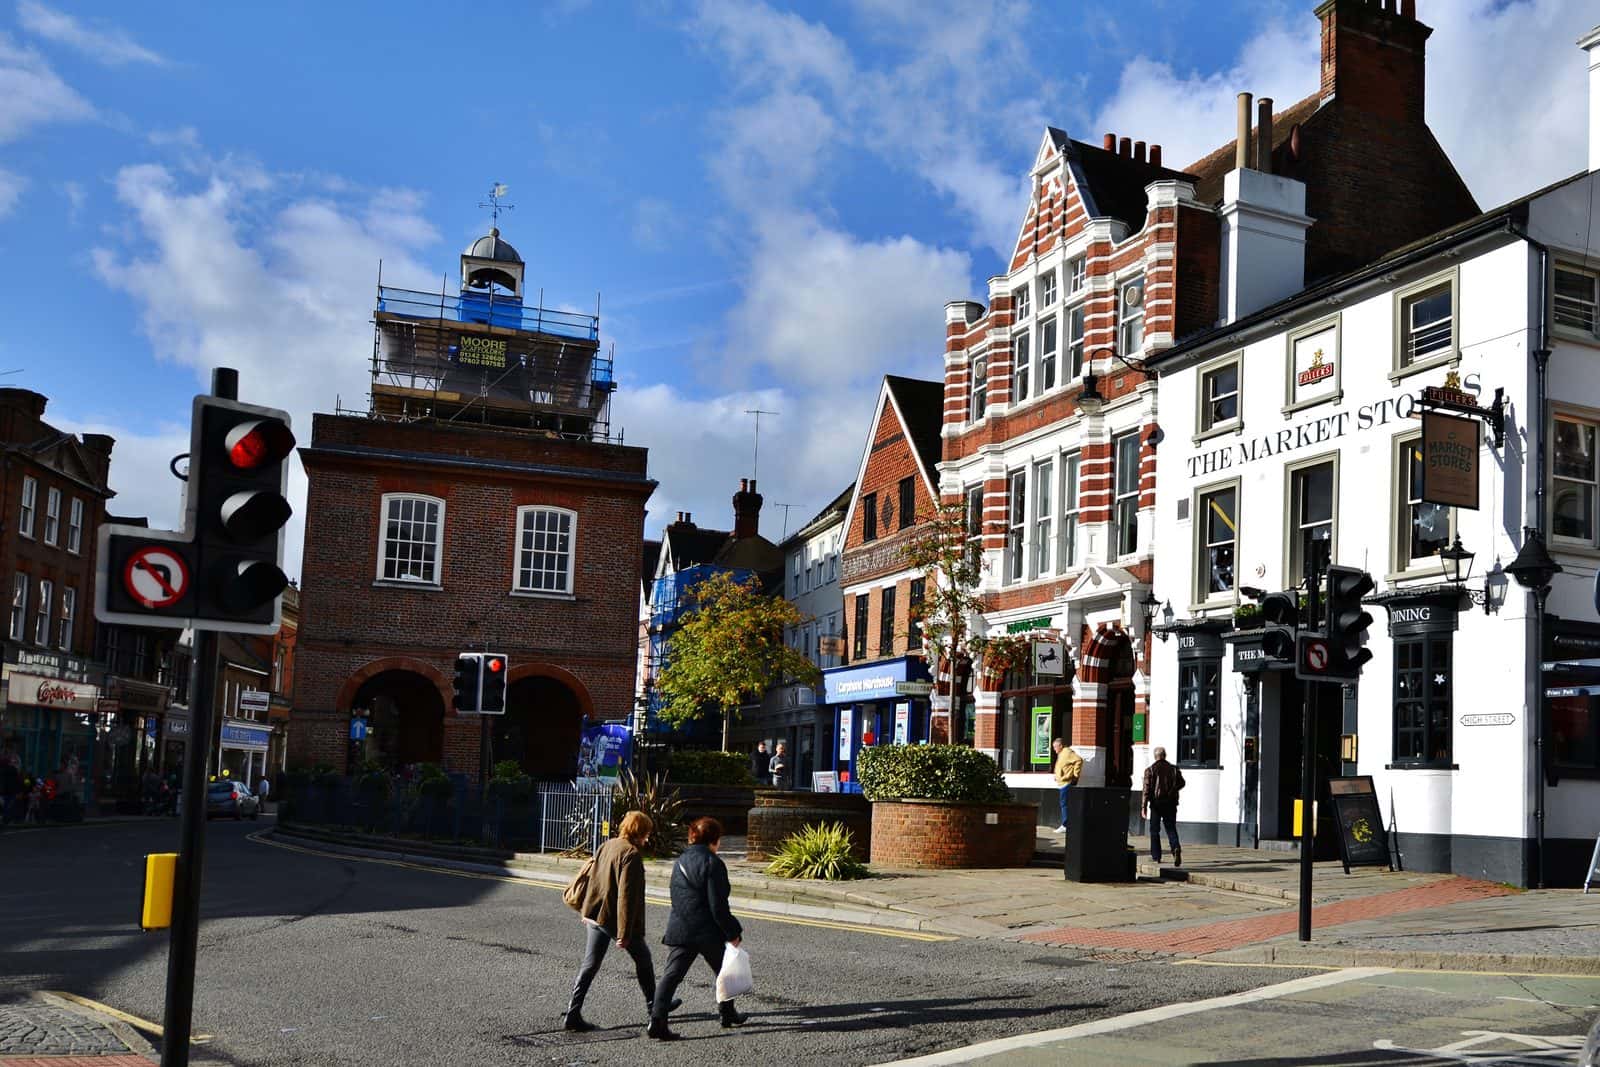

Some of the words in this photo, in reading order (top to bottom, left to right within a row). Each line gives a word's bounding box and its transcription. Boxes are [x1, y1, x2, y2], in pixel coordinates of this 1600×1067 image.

[460, 336, 507, 351] MOORE
[1187, 446, 1232, 479] THE
[1239, 411, 1350, 465] MARKET
[1357, 373, 1482, 431] STOS
[1428, 439, 1474, 460] MARKET
[1429, 453, 1473, 473] STORES
[1391, 607, 1431, 624] DINING
[1180, 636, 1195, 649] PUB
[1238, 649, 1256, 661] THE
[1465, 715, 1483, 724] HIGH
[1484, 714, 1510, 724] STREET
